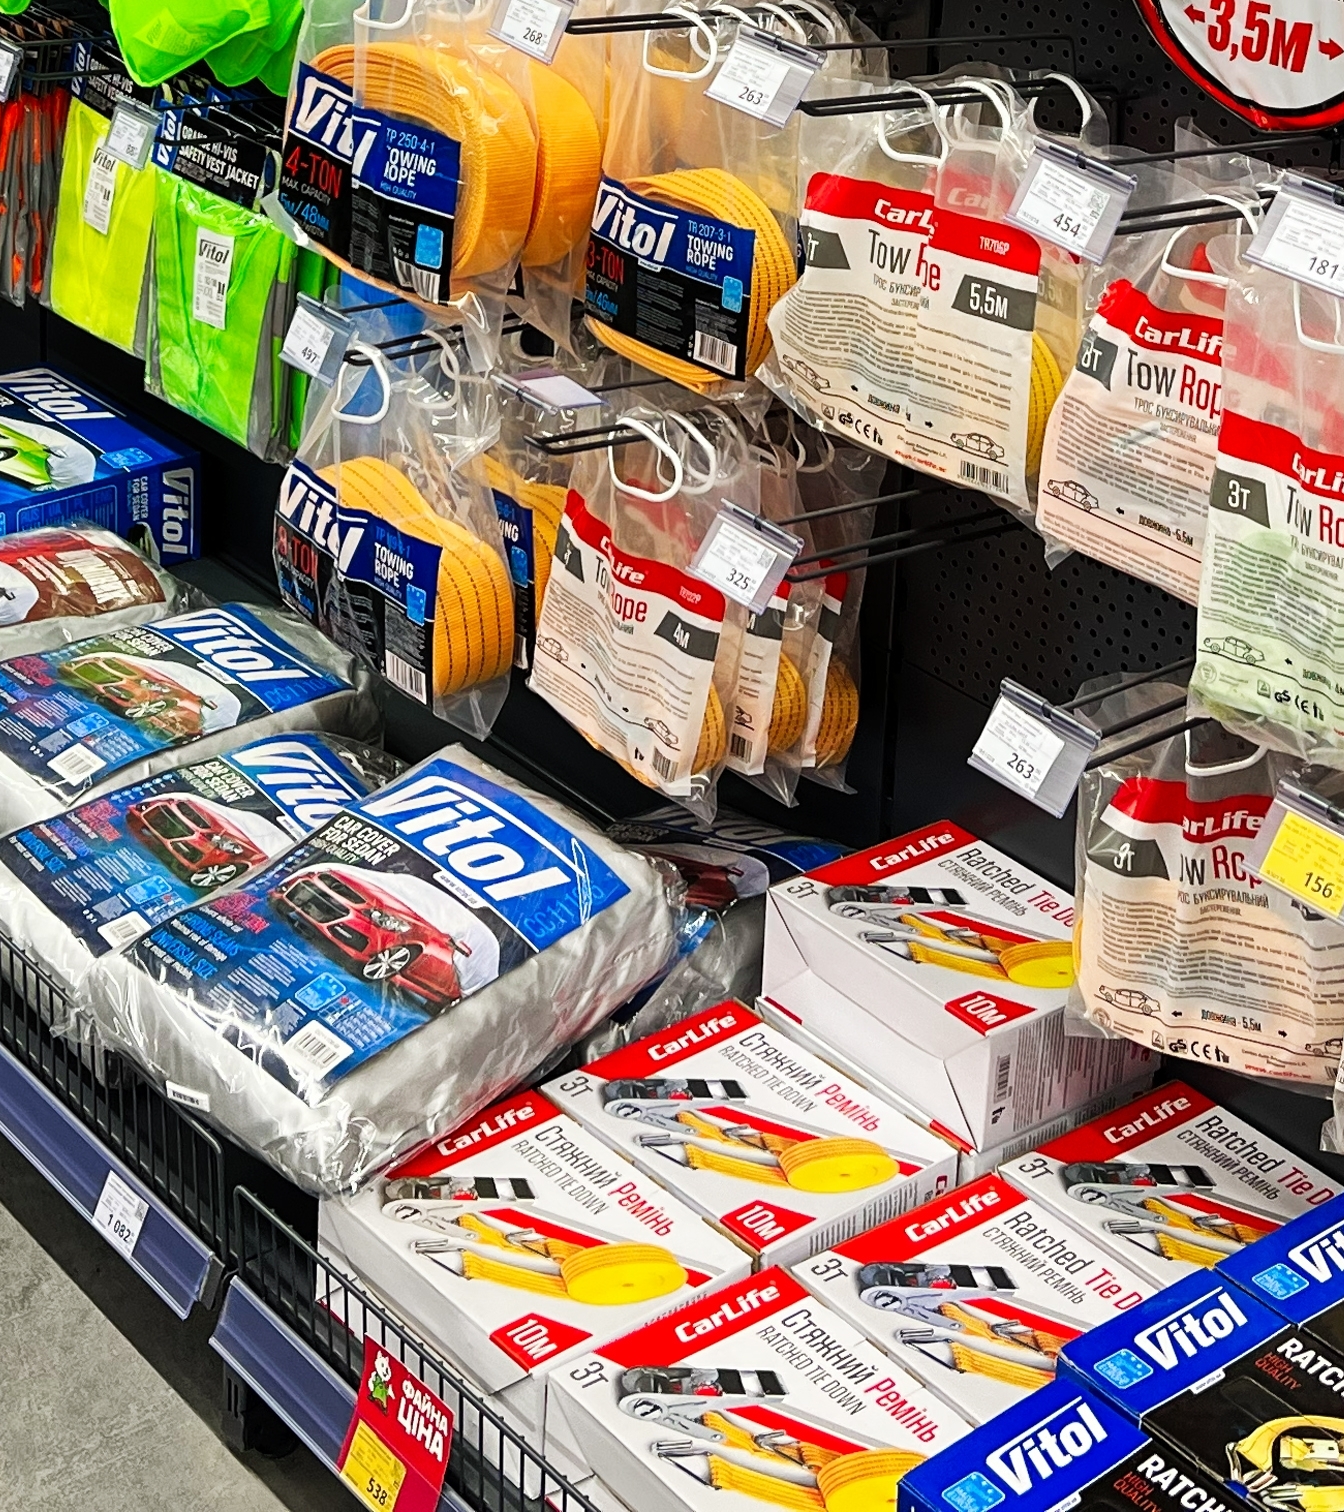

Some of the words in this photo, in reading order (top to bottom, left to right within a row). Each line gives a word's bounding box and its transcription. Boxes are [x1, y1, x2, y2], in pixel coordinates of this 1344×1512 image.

[522, 29, 544, 45] 268
[738, 85, 764, 105] 263
[178, 143, 205, 167] SAFETY
[205, 153, 226, 176] VEST
[227, 162, 259, 189] JACKET
[397, 132, 435, 155] 250-4-1
[286, 146, 343, 199] 4-TON
[591, 181, 679, 263] Vitol
[1054, 212, 1081, 239] 454
[587, 241, 624, 285] 3-TON
[686, 248, 716, 271] ROPE
[687, 234, 734, 261] TOWING
[1308, 256, 1340, 279] 181
[374, 542, 414, 580] TOWING
[374, 559, 401, 588] ROPE
[726, 567, 750, 591] 325
[1006, 752, 1035, 780] 263
[319, 826, 348, 847] FOR
[346, 839, 387, 866] SEDAN
[334, 815, 362, 835] CAR
[360, 828, 401, 862] COVER
[360, 775, 585, 902] Vitol
[869, 828, 956, 872] CarLife
[938, 858, 994, 896] СТЯЖНИЙ
[993, 888, 1029, 918] РЕМІНЬ
[955, 839, 1034, 898] Ratched
[1026, 889, 1062, 919] Tie
[1304, 870, 1334, 900] 156
[646, 1013, 738, 1061] CarLife
[718, 1045, 768, 1080] RATCHED
[765, 1077, 785, 1092] TIE
[777, 1085, 818, 1113] DOWN
[436, 1102, 537, 1158] CarLife
[1103, 1092, 1192, 1145] CarLife
[1176, 1128, 1230, 1172] СТЯЖНИЙ
[1227, 1164, 1282, 1202] РЕМІНЬ
[1194, 1114, 1280, 1172] Ratched
[1276, 1164, 1312, 1197] Tie
[904, 1188, 1001, 1242] CarLife
[982, 1226, 1041, 1279] СТЯЖНИЙ
[1038, 1272, 1087, 1305] РЕМІНЬ
[1002, 1209, 1093, 1276] Ratched
[1082, 1266, 1119, 1304] Tie
[673, 1281, 781, 1344] CarLife
[756, 1325, 813, 1372] RATCHED
[809, 1365, 831, 1385] TIE
[821, 1377, 867, 1417] DOWN
[1254, 1357, 1302, 1391] QUALITY
[397, 1396, 443, 1462] ЦІНА
[402, 1380, 448, 1437] ФАЙНА
[366, 1477, 388, 1506] 538
